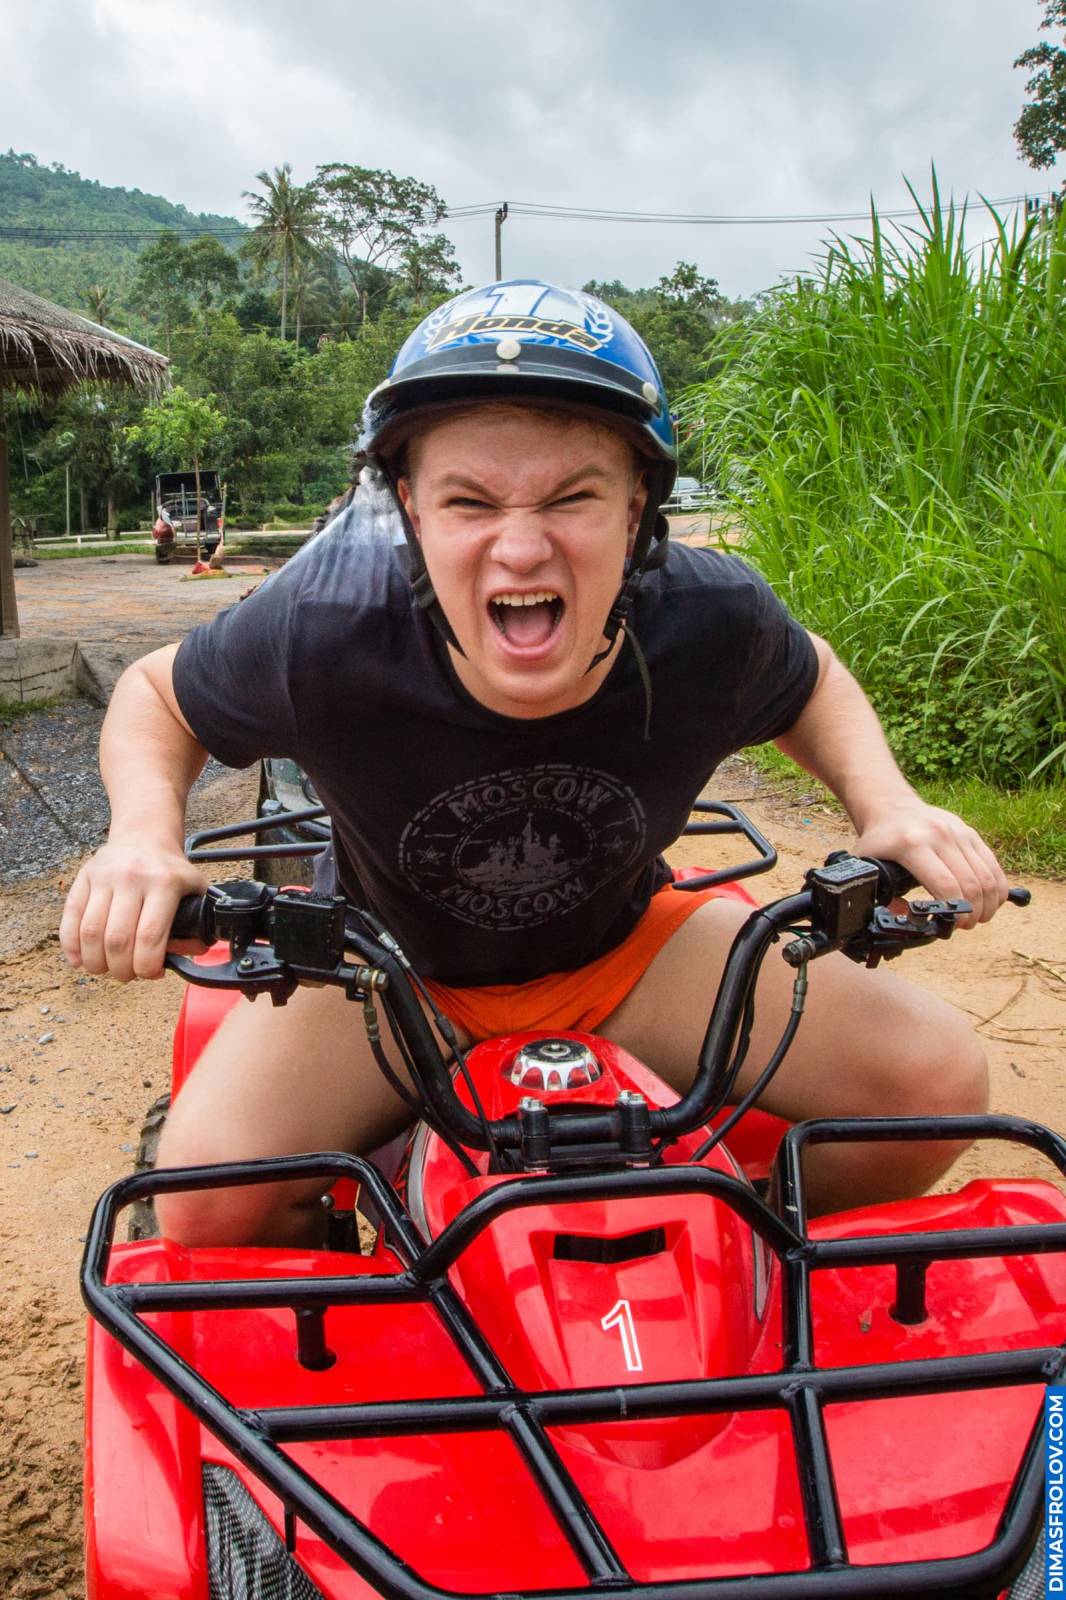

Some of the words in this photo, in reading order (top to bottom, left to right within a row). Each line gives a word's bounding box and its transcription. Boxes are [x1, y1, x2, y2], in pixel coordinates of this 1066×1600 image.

[449, 777, 614, 824] MOSCOW
[441, 877, 586, 919] MOSCOW
[601, 1299, 643, 1371] 1
